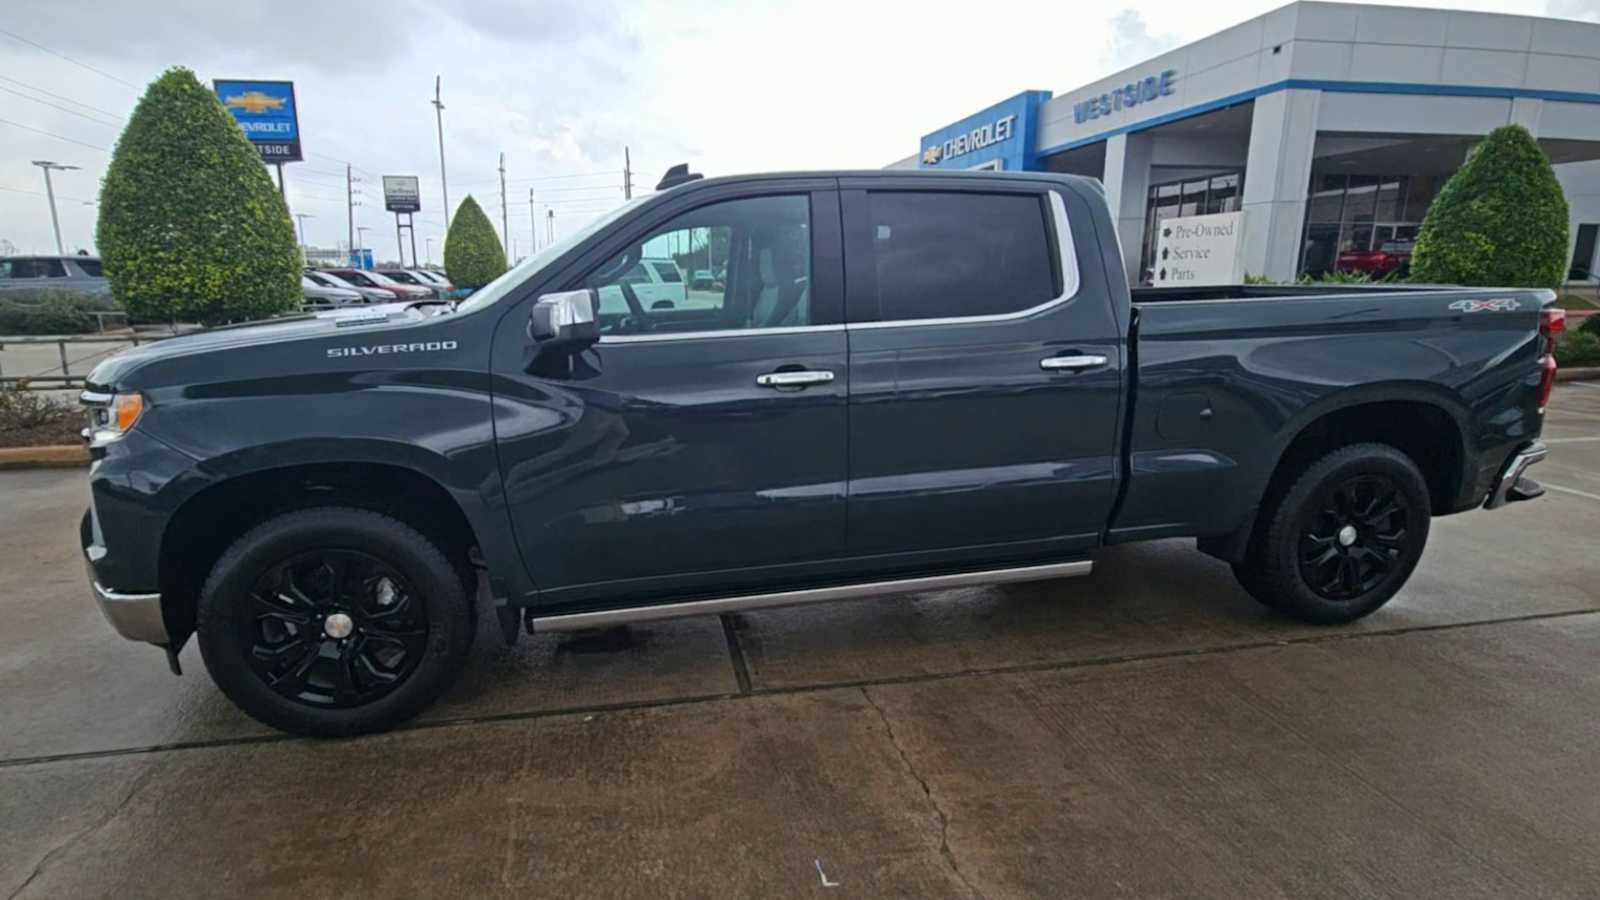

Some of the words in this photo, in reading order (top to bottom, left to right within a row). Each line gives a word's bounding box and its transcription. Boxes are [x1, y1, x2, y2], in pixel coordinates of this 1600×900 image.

[1073, 70, 1176, 124] WESTSIDE
[239, 122, 291, 133] EVROLET
[943, 115, 1015, 160] CHEVROLET
[258, 145, 290, 155] TSIDE
[1175, 221, 1234, 239] Pre-Owned
[1173, 247, 1211, 260] Service
[1171, 267, 1195, 281] Parts
[327, 341, 457, 357] SILVERADO
